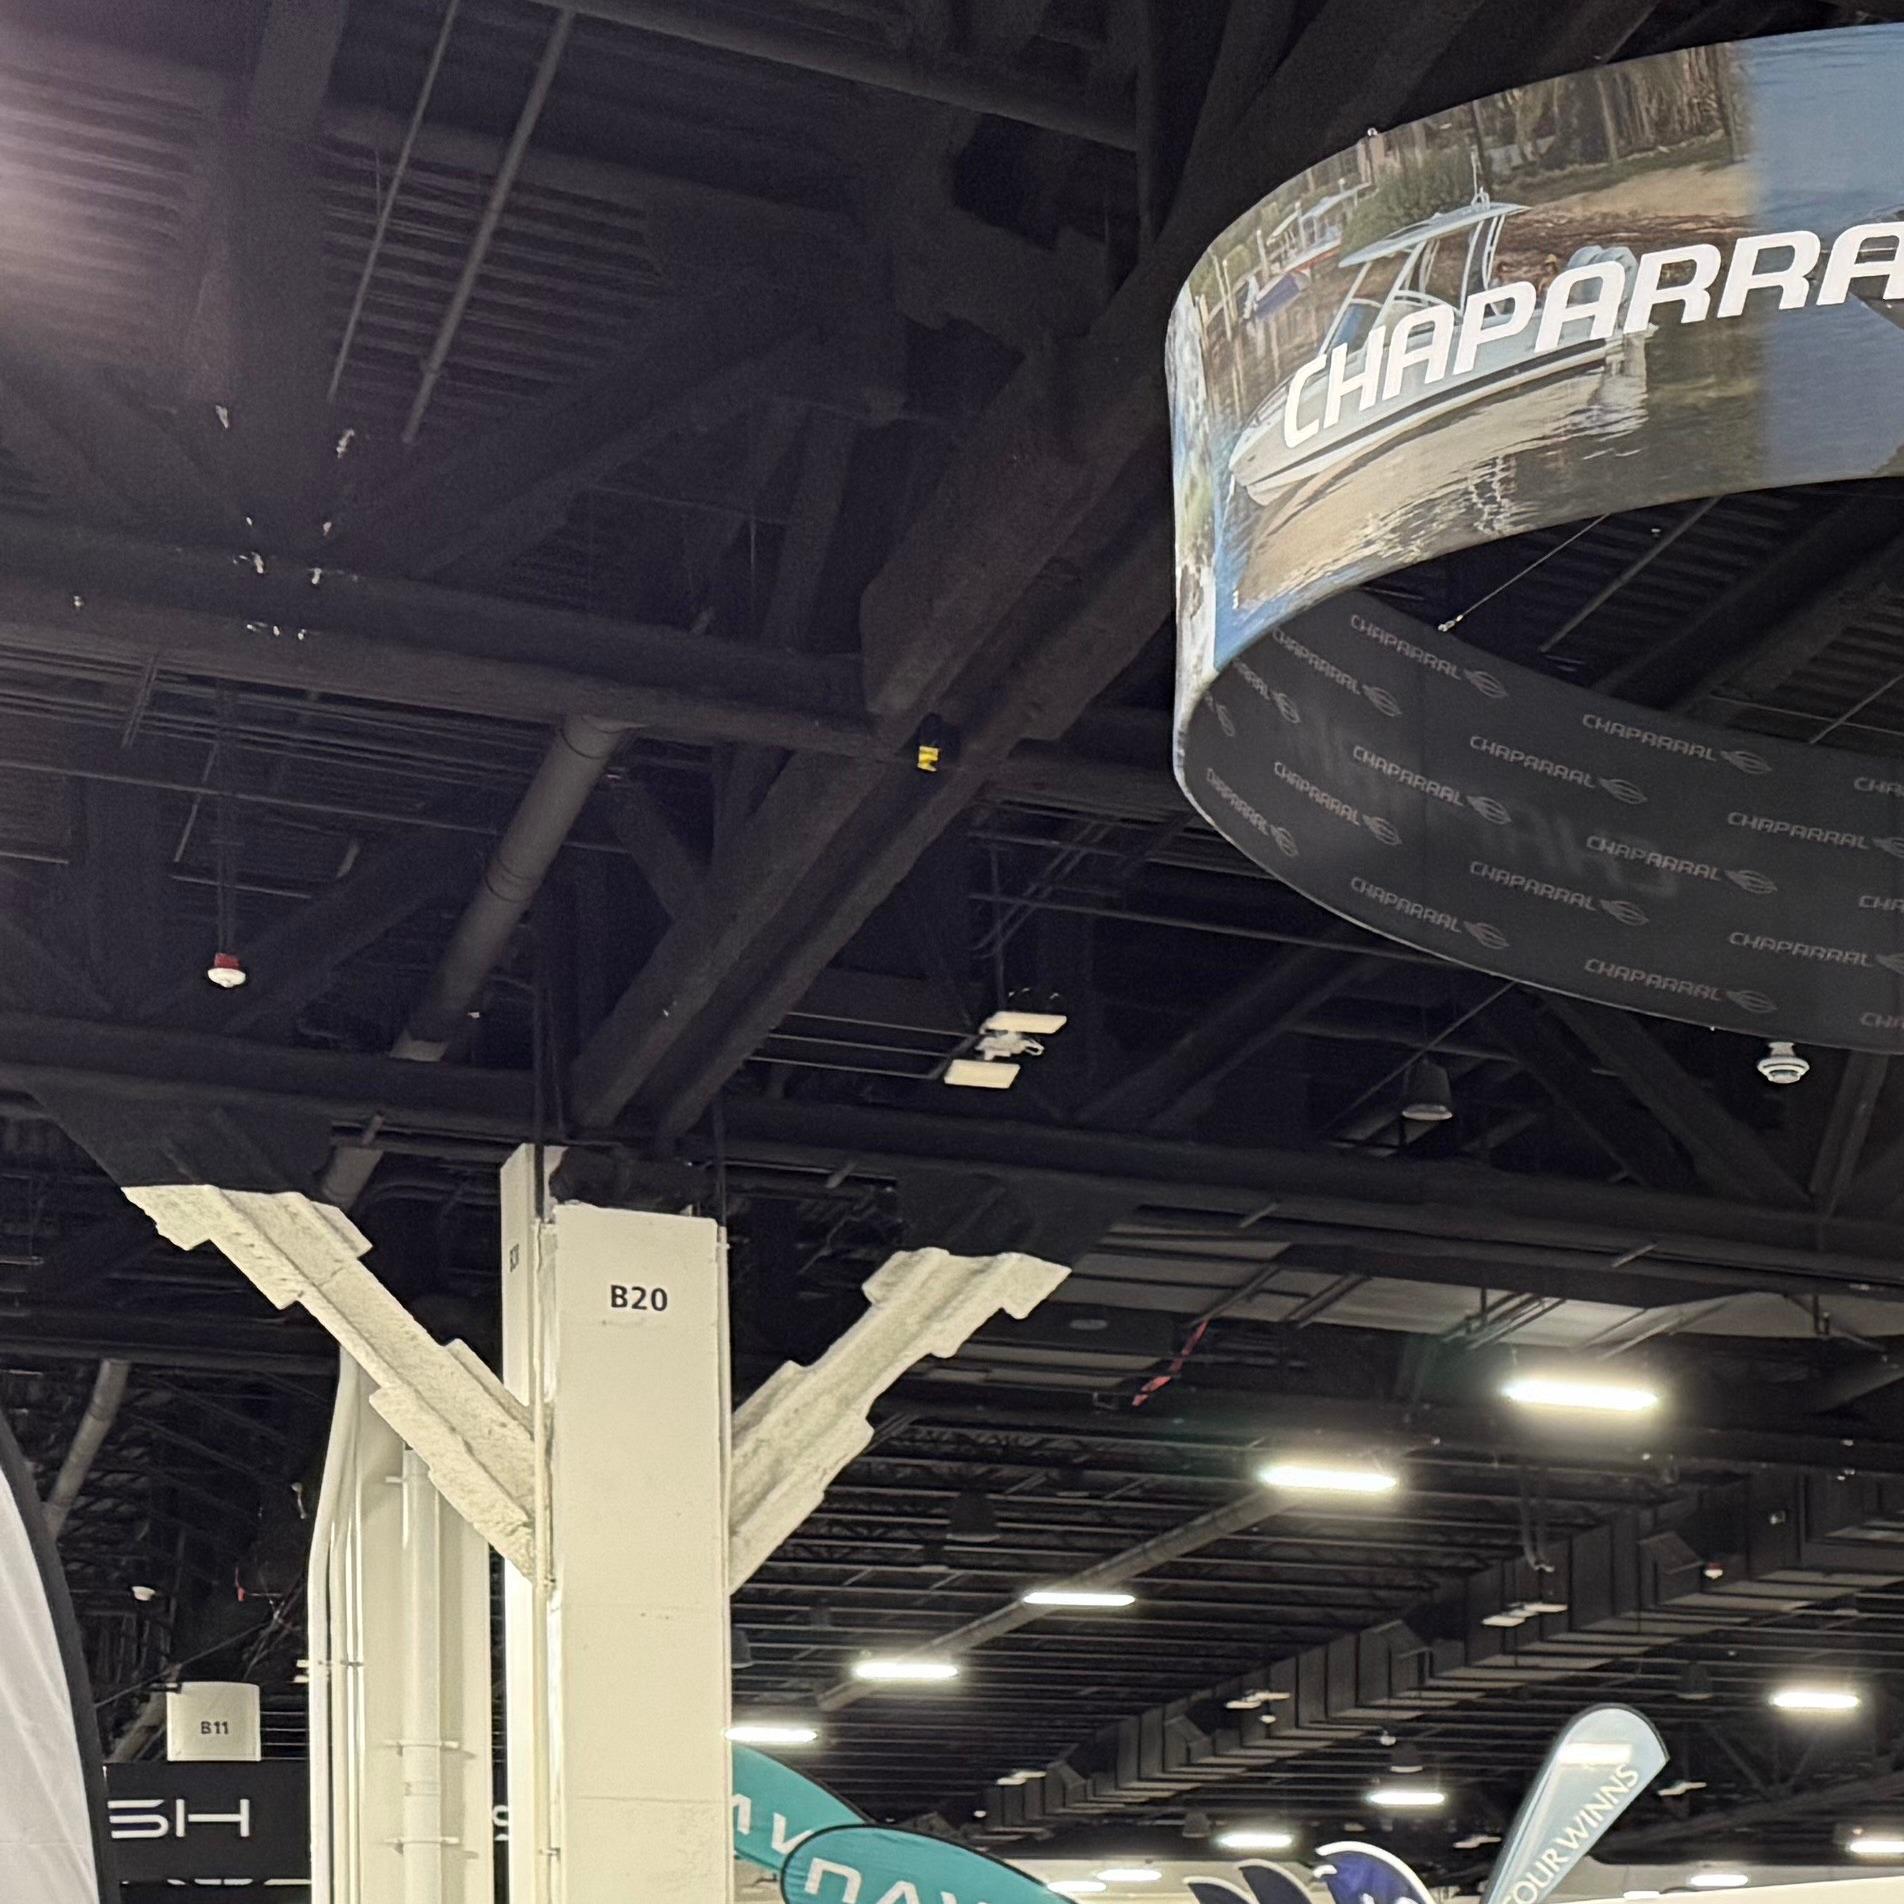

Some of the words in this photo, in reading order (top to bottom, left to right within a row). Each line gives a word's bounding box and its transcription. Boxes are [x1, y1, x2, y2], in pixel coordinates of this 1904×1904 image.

[1583, 714, 1717, 762] CHAPARRAL
[1353, 745, 1465, 807] CHAPARRAL
[1470, 735, 1597, 789] CHAPARRAL
[1727, 811, 1869, 851] CHAPARRAL
[1585, 835, 1721, 882] CHAPARRAL
[1351, 876, 1462, 934] CHAPARRAL
[1470, 861, 1598, 911] CHAPARRAL
[1728, 932, 1875, 968] CHAPARRAL
[1584, 958, 1721, 1002] CHAPARRAL
[610, 1284, 668, 1312] B20
[200, 1721, 229, 1735] B11
[1560, 1763, 1640, 1852] WINNS
